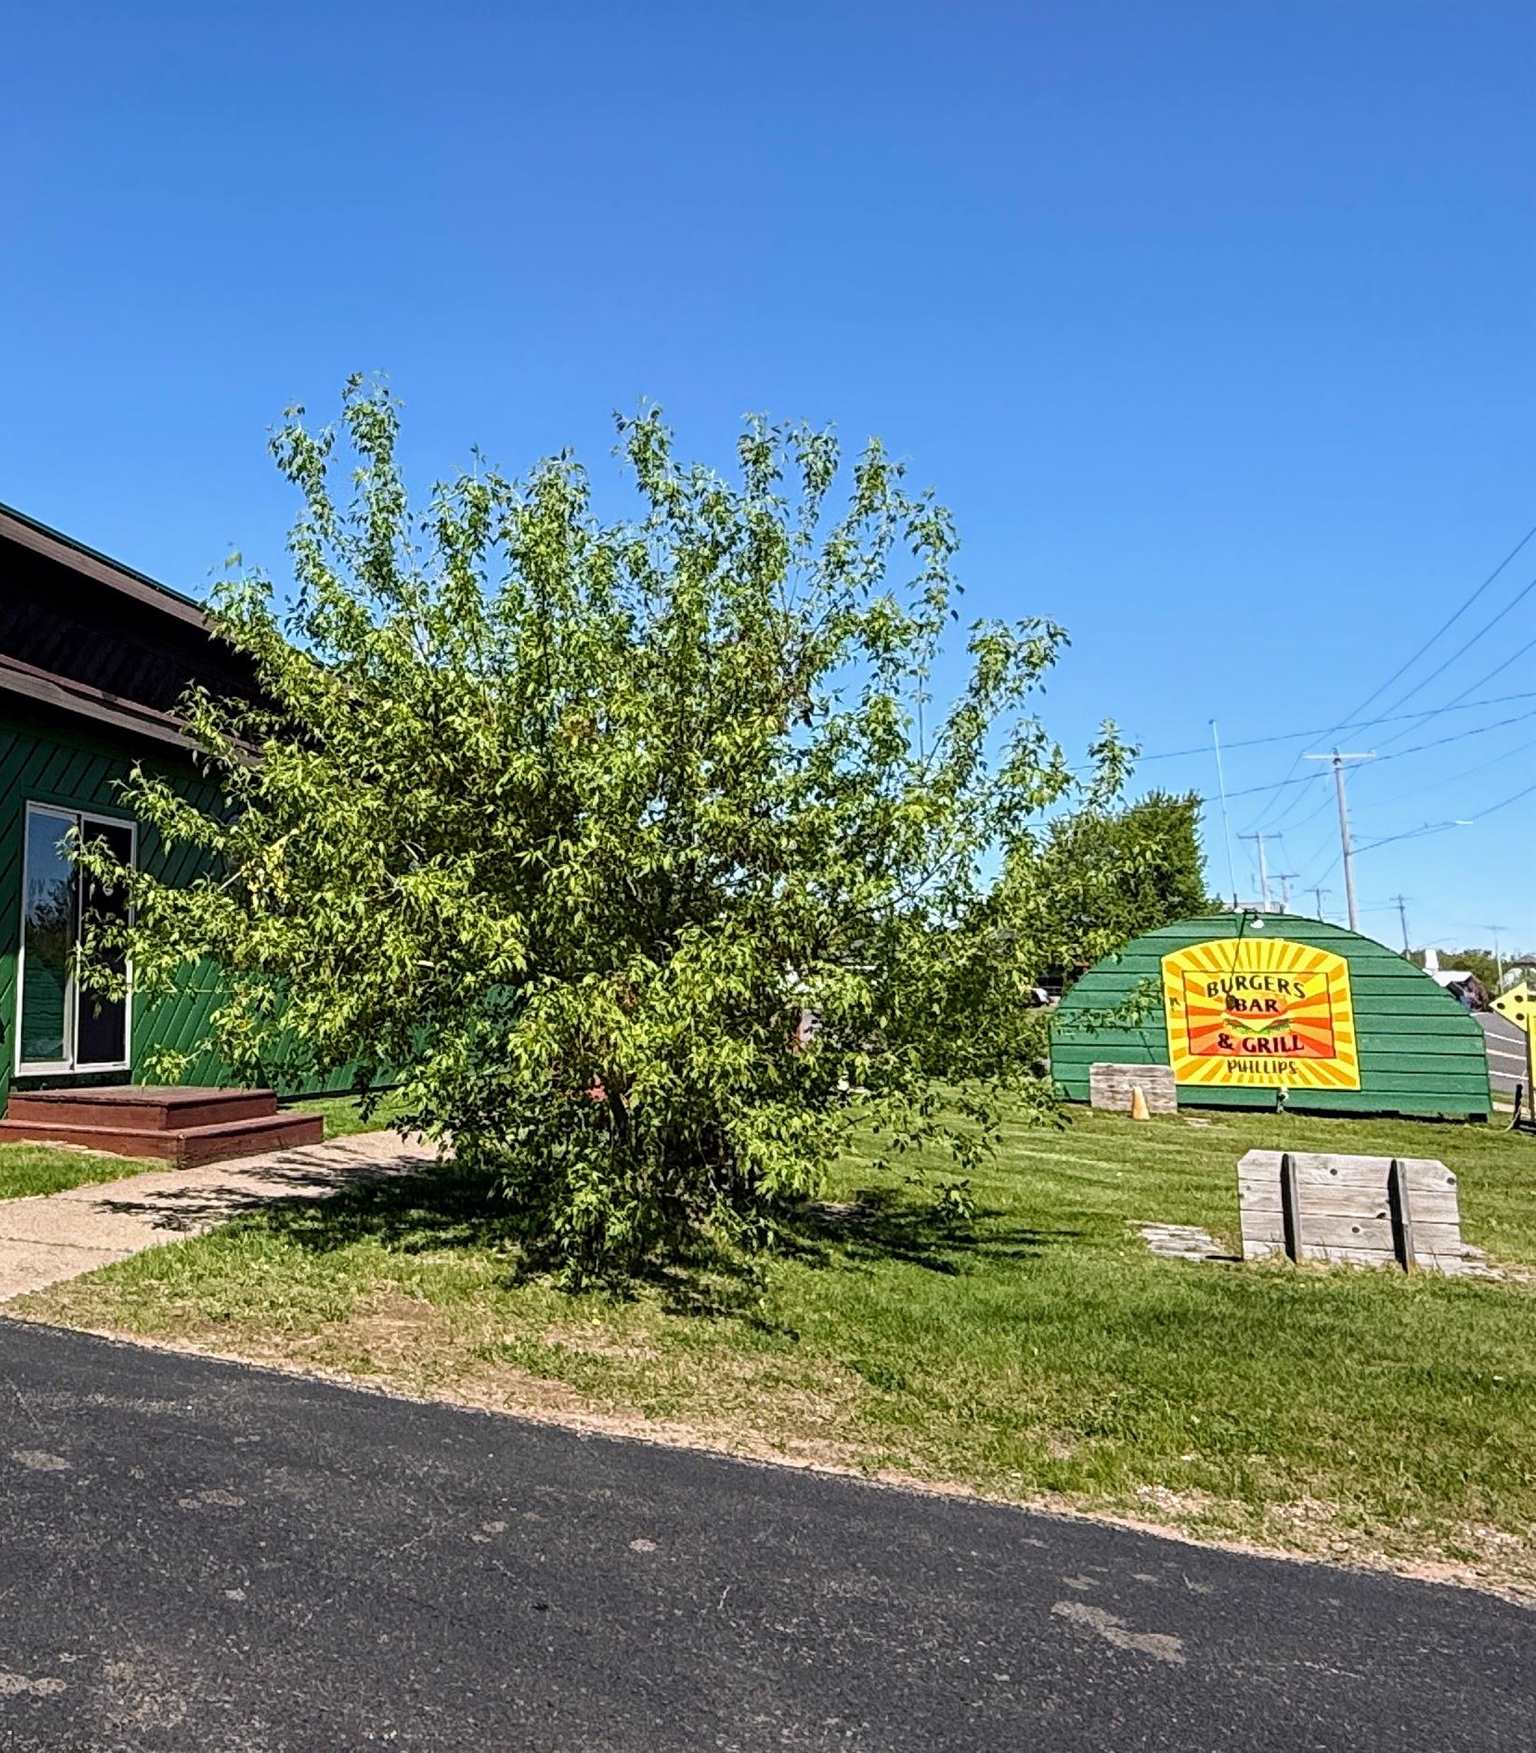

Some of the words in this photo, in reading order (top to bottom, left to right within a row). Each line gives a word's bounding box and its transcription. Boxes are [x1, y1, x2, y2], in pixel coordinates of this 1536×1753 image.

[1206, 975, 1306, 999] BURGERS
[1234, 998, 1279, 1013] BAR
[1217, 1032, 1234, 1050] &
[1242, 1034, 1305, 1054] GRILL
[1227, 1059, 1298, 1075] PHILLIPS
